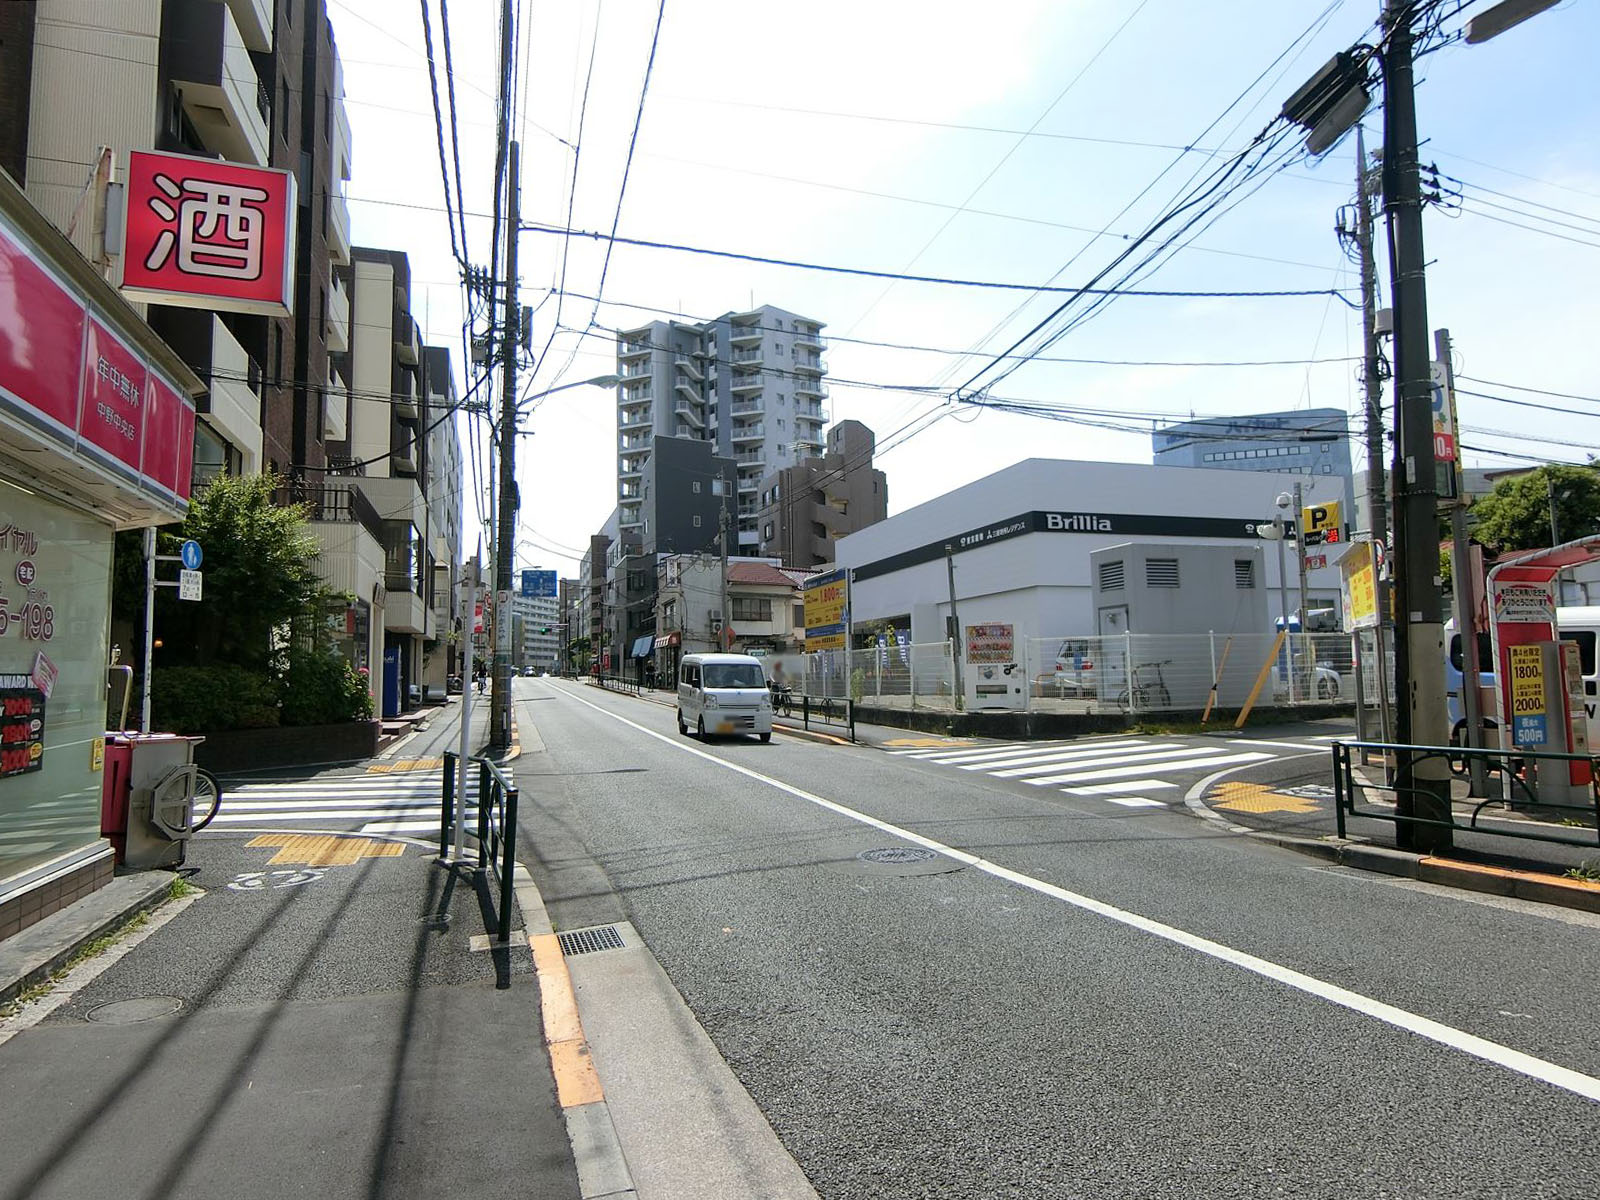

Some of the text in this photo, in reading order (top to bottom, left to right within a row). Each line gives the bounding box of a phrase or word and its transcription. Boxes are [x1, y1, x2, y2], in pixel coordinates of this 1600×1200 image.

[145, 172, 268, 281] 酒
[96, 356, 140, 408] 年中無休
[96, 400, 136, 442] 中野中央店
[1434, 436, 1453, 458] 0円
[1046, 513, 1112, 531] Brillia
[1312, 508, 1327, 529] P
[1518, 729, 1543, 742] 500円
